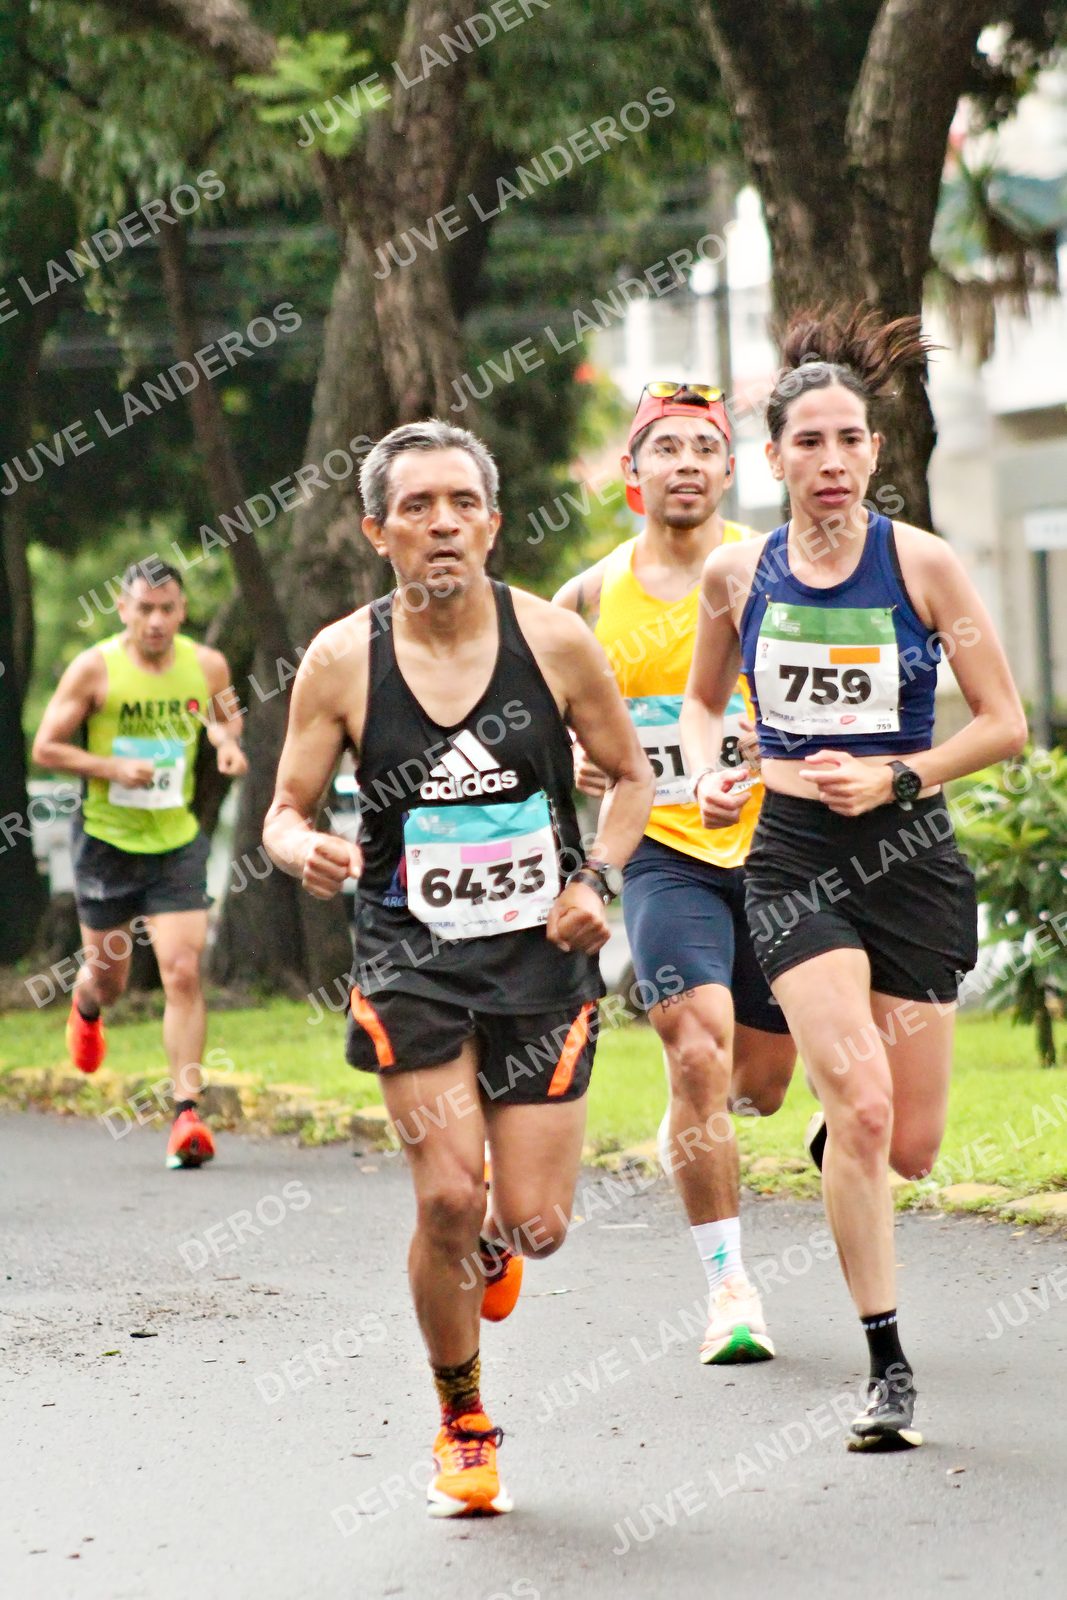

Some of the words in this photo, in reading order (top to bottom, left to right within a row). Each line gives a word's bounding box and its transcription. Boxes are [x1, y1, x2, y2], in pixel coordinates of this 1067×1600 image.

[779, 664, 872, 705] 759
[643, 736, 744, 778] 518
[420, 770, 519, 800] adidas
[421, 853, 546, 908] 6433
